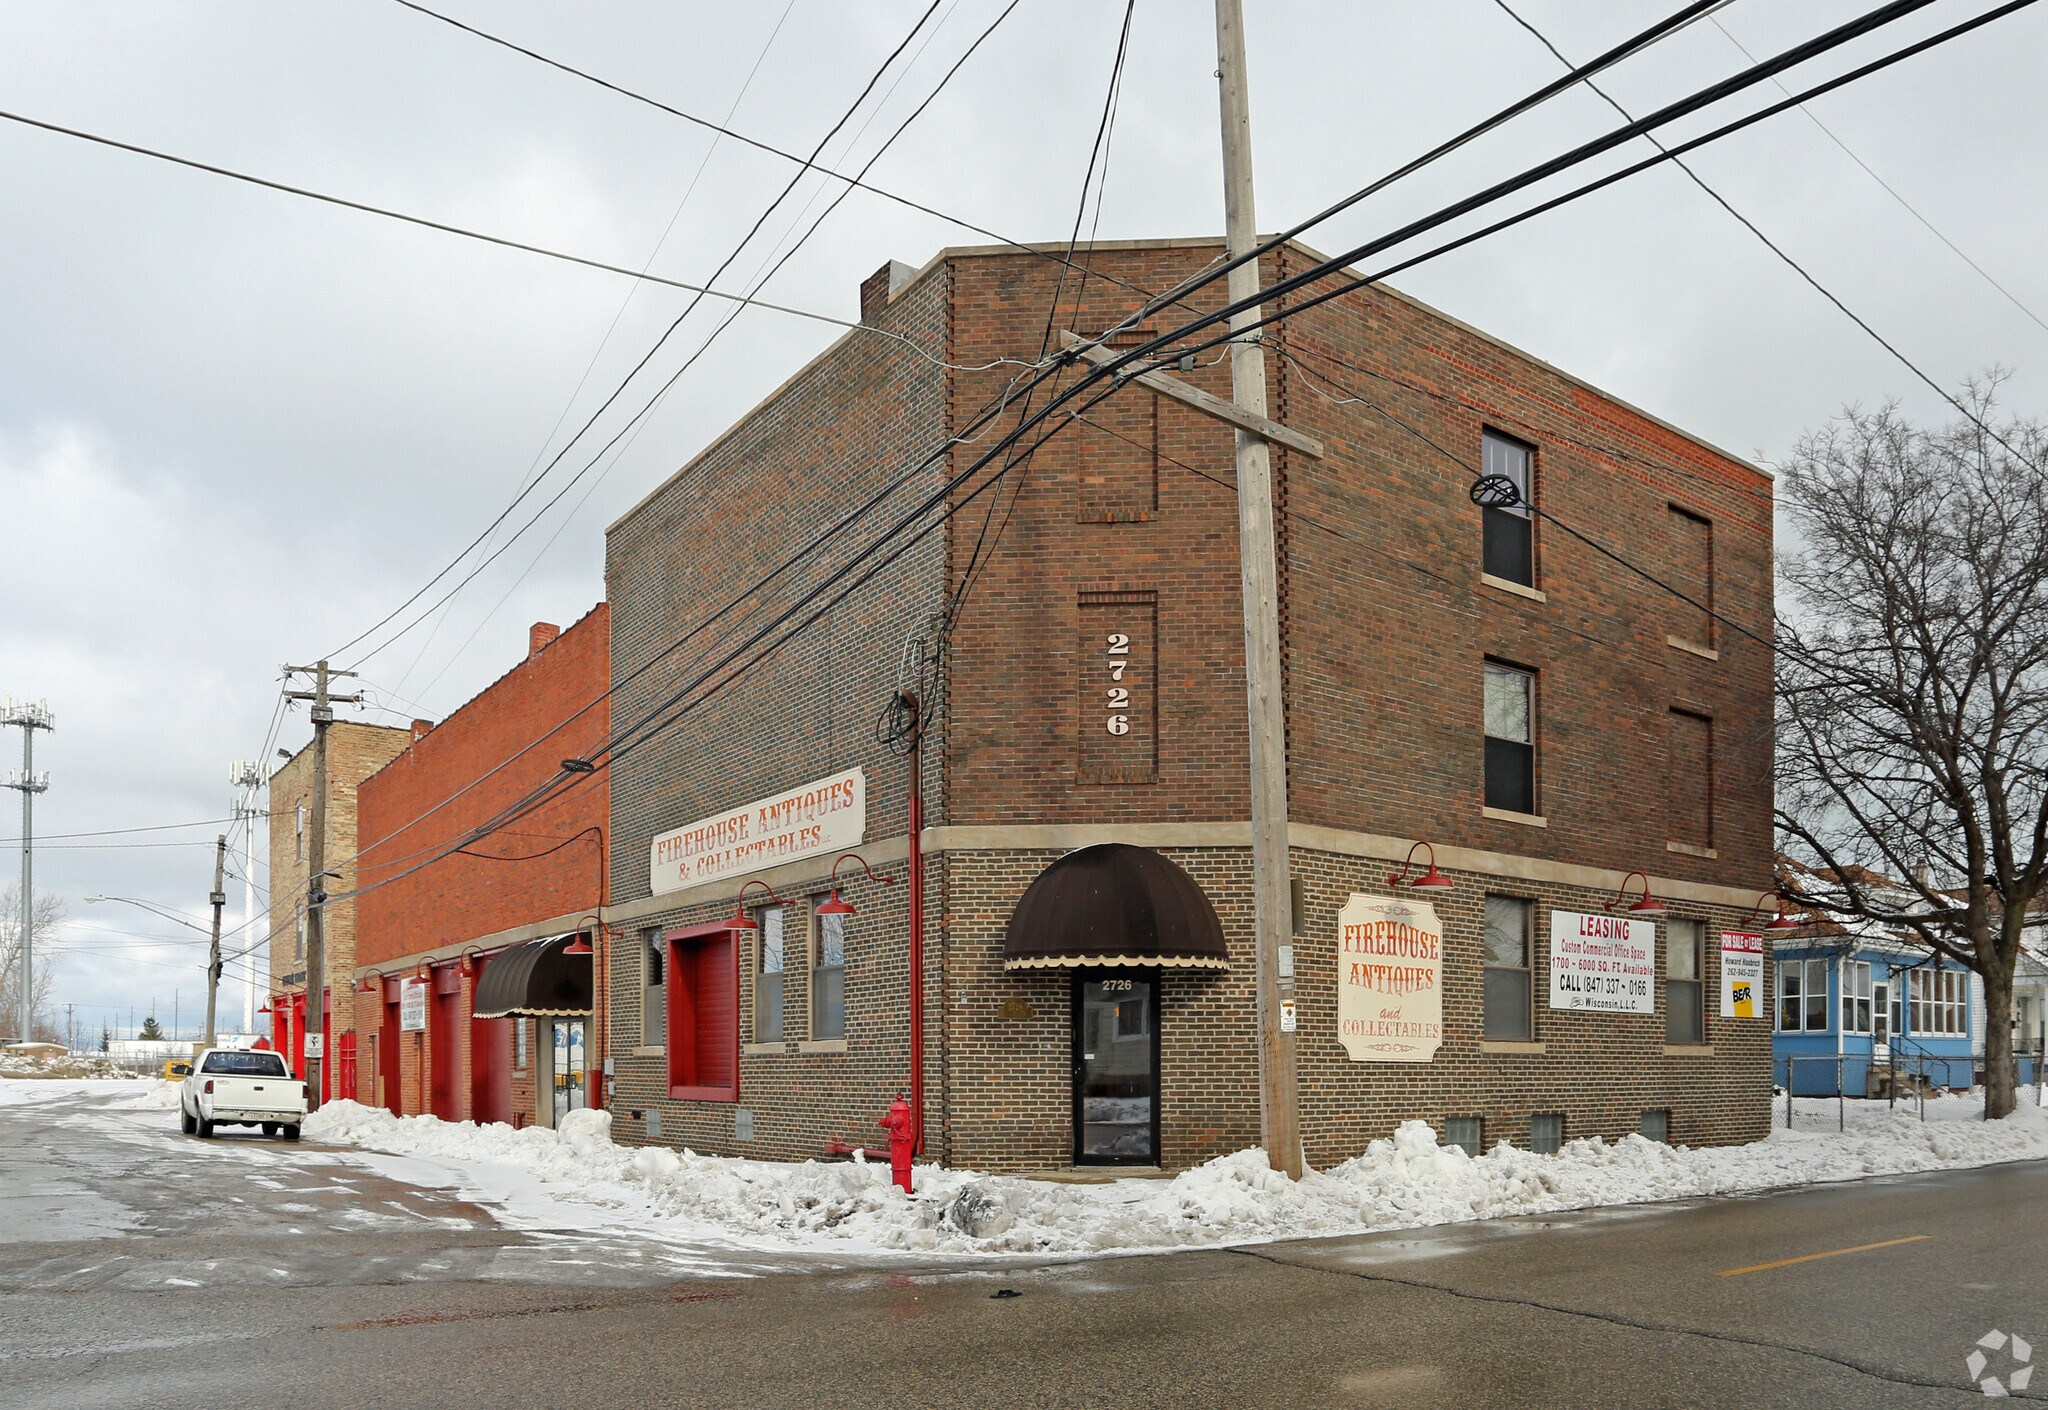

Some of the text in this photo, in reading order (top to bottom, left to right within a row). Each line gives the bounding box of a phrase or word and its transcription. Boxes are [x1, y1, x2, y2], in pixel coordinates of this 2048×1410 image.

[1107, 633, 1129, 736] 2726
[657, 778, 854, 866] FIREHOUSE ANTIQUES
[679, 863, 690, 880] &
[697, 824, 822, 877] COLLECTABLES
[1580, 915, 1630, 940] LEASING
[1344, 920, 1439, 960] FIREHOUSE
[1561, 938, 1646, 962] Custom Commercial Office Space
[1722, 934, 1732, 948] FOR
[1732, 935, 1744, 949] SALE
[1749, 936, 1763, 950] LEASE
[1552, 956, 1570, 969] 1700
[1578, 959, 1595, 971] 6000
[1597, 960, 1610, 973] SQ.
[1623, 963, 1653, 976] Available
[1102, 979, 1132, 991] 2726
[1348, 962, 1434, 997] ANTIQUES
[1560, 974, 1581, 992] CALL
[1583, 975, 1604, 994] (847)
[1606, 978, 1620, 995] 337
[1629, 980, 1647, 996] 0166
[1379, 1005, 1403, 1020] and
[1342, 1019, 1440, 1039] COLLECTABLES
